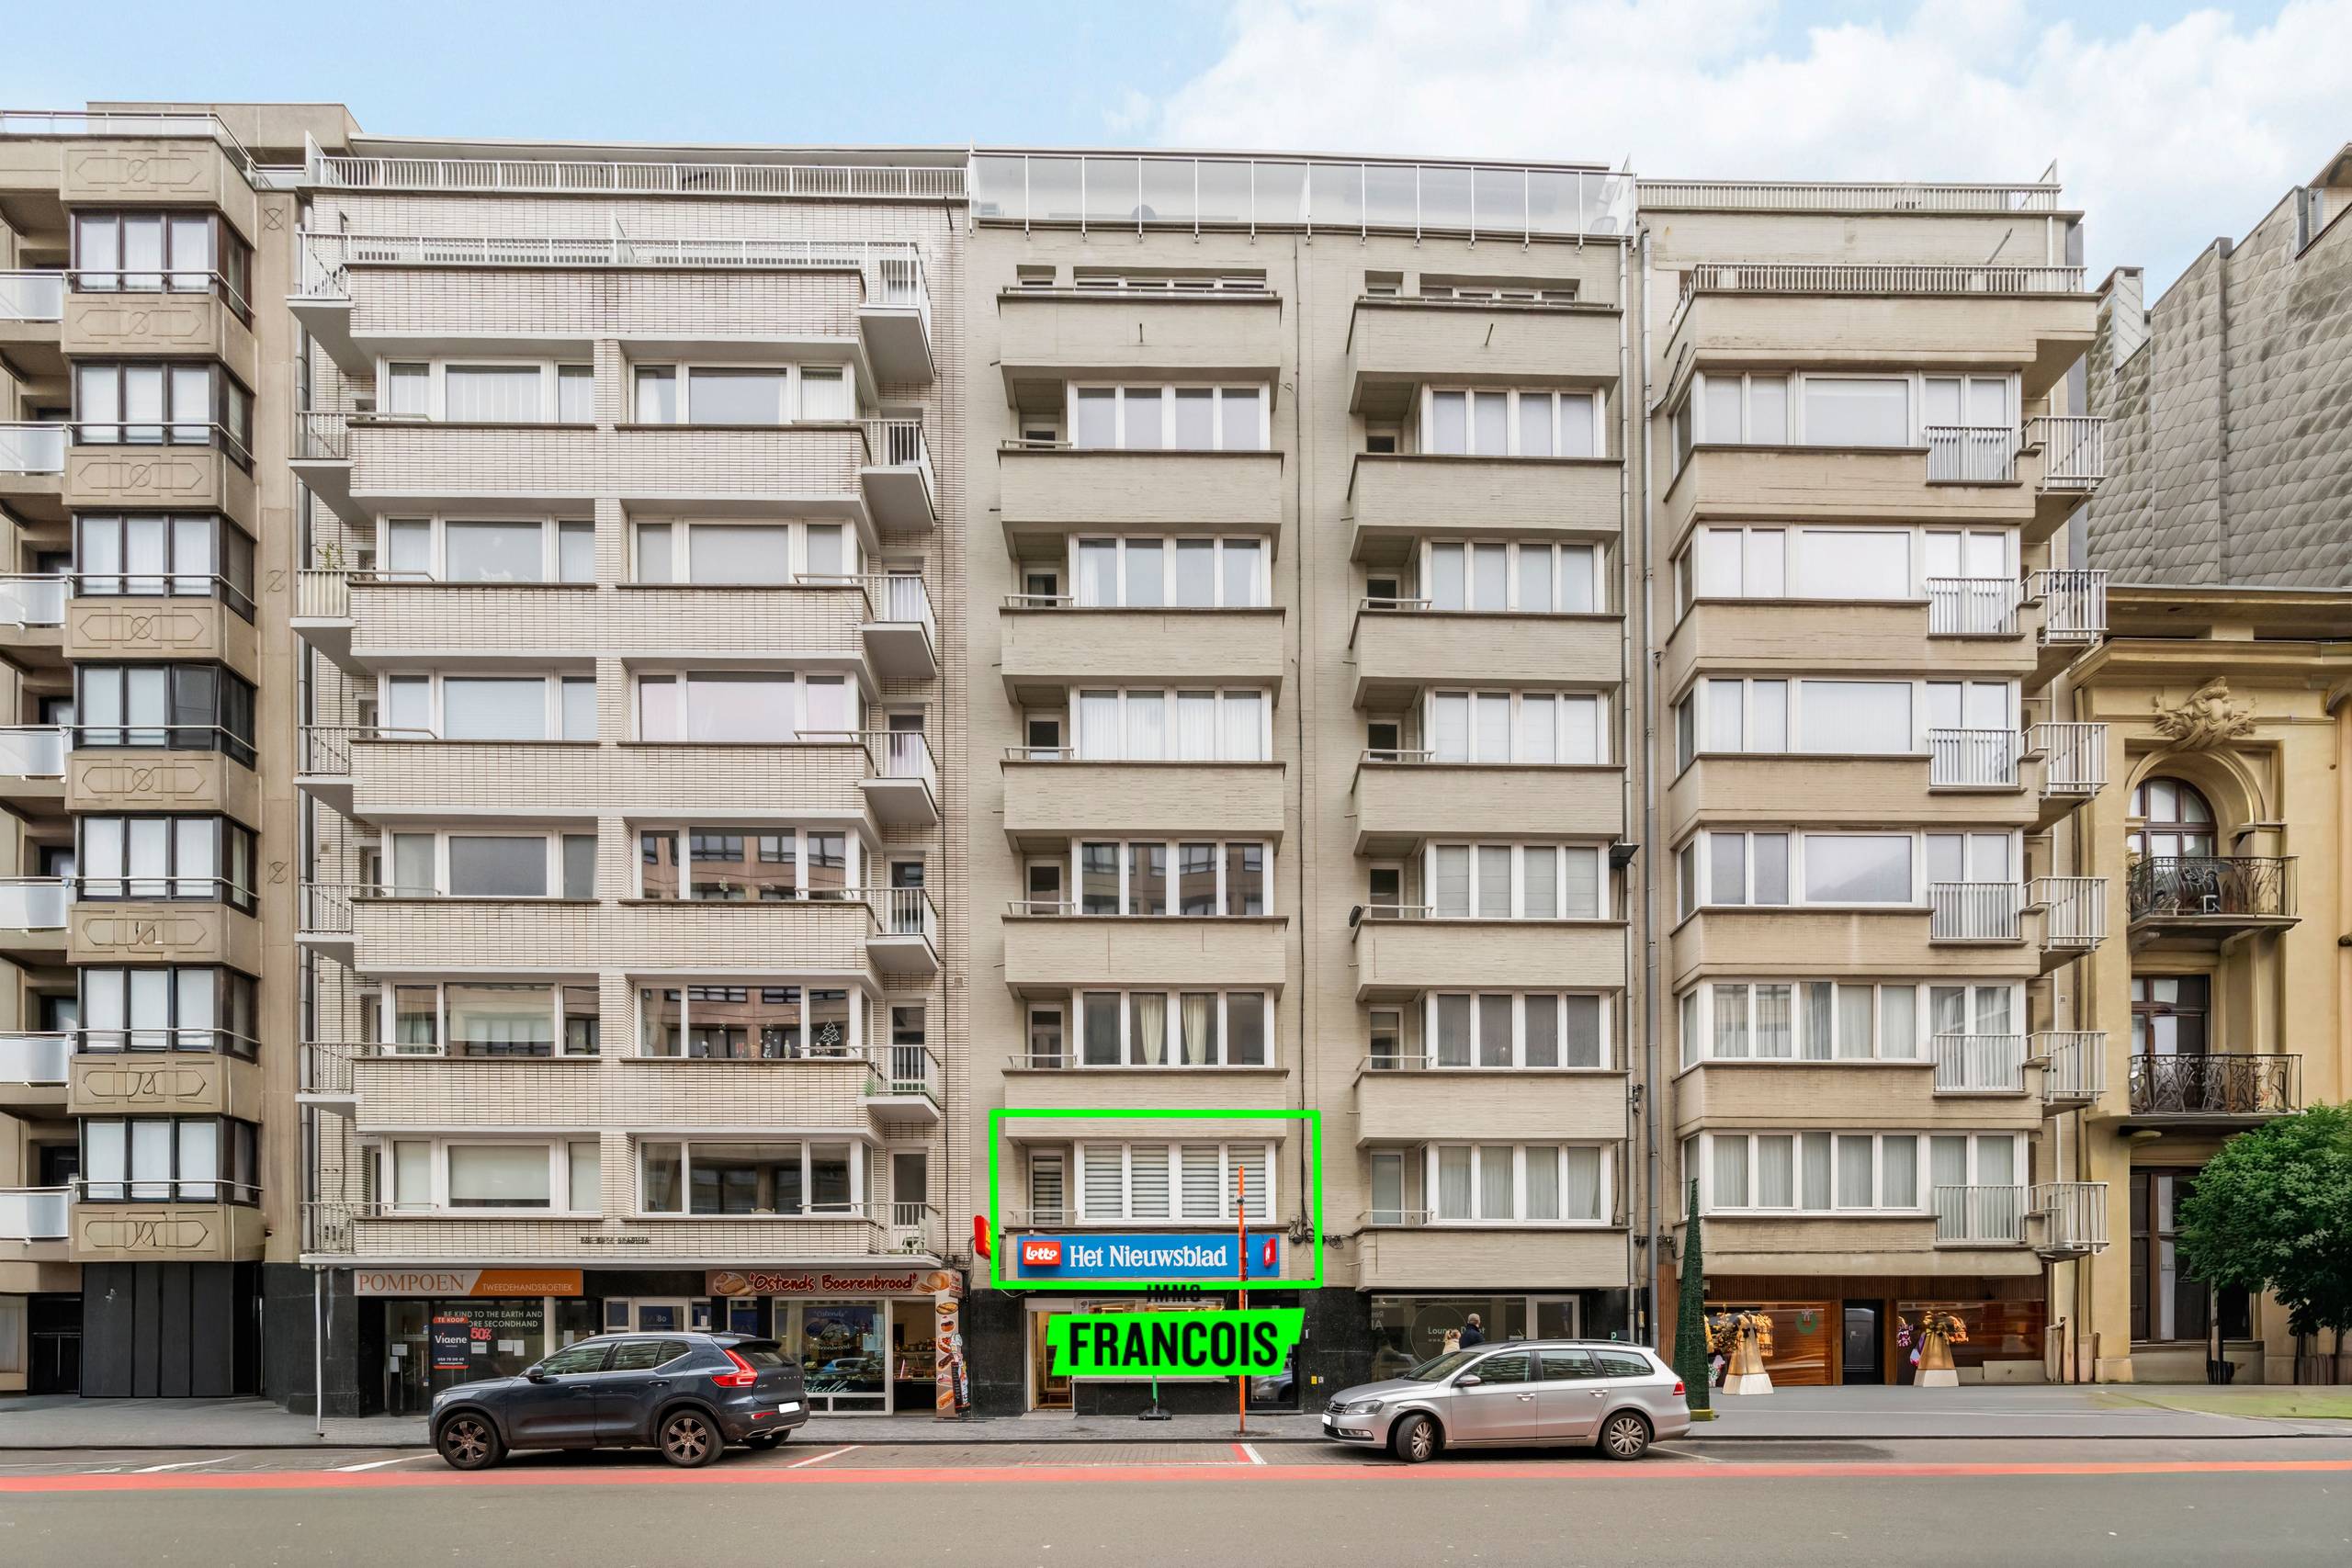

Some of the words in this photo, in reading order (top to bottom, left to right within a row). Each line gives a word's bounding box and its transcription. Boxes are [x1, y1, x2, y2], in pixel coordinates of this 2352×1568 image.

[1069, 1245, 1104, 1268] Het
[1109, 1245, 1228, 1268] Nieuwsblad
[358, 1274, 464, 1292] POMPOEN
[482, 1283, 573, 1292] TWEEDEHANDSBOETIEK
[435, 1332, 468, 1344] Viaene
[470, 1327, 492, 1341] 50%
